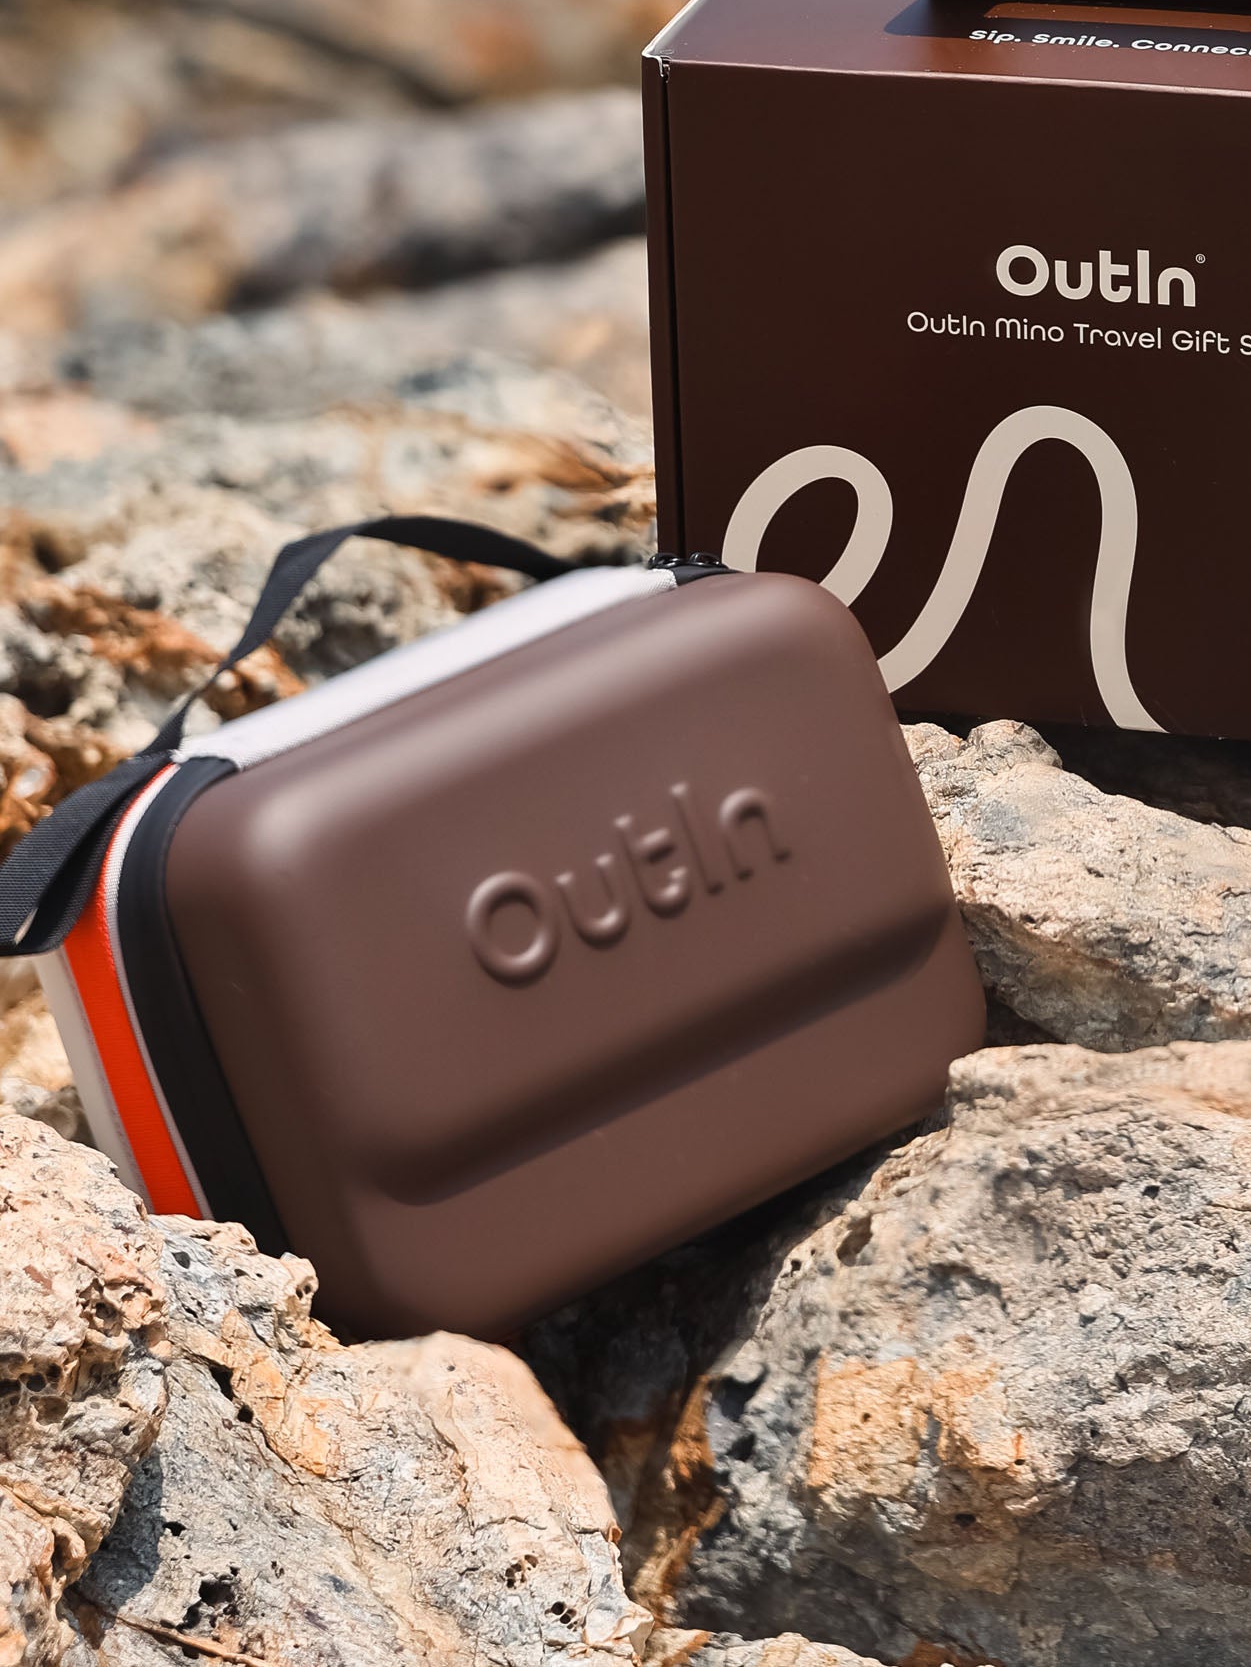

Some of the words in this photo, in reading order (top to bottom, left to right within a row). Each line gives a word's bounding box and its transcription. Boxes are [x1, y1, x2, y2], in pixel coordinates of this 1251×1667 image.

[968, 30, 1021, 44] Sip.
[1031, 33, 1120, 48] Smile.
[906, 311, 986, 337] OutIn
[995, 317, 1064, 343] Mino
[1073, 323, 1162, 350] Travel
[1171, 329, 1230, 354] Gift
[464, 781, 793, 990] OutIn
